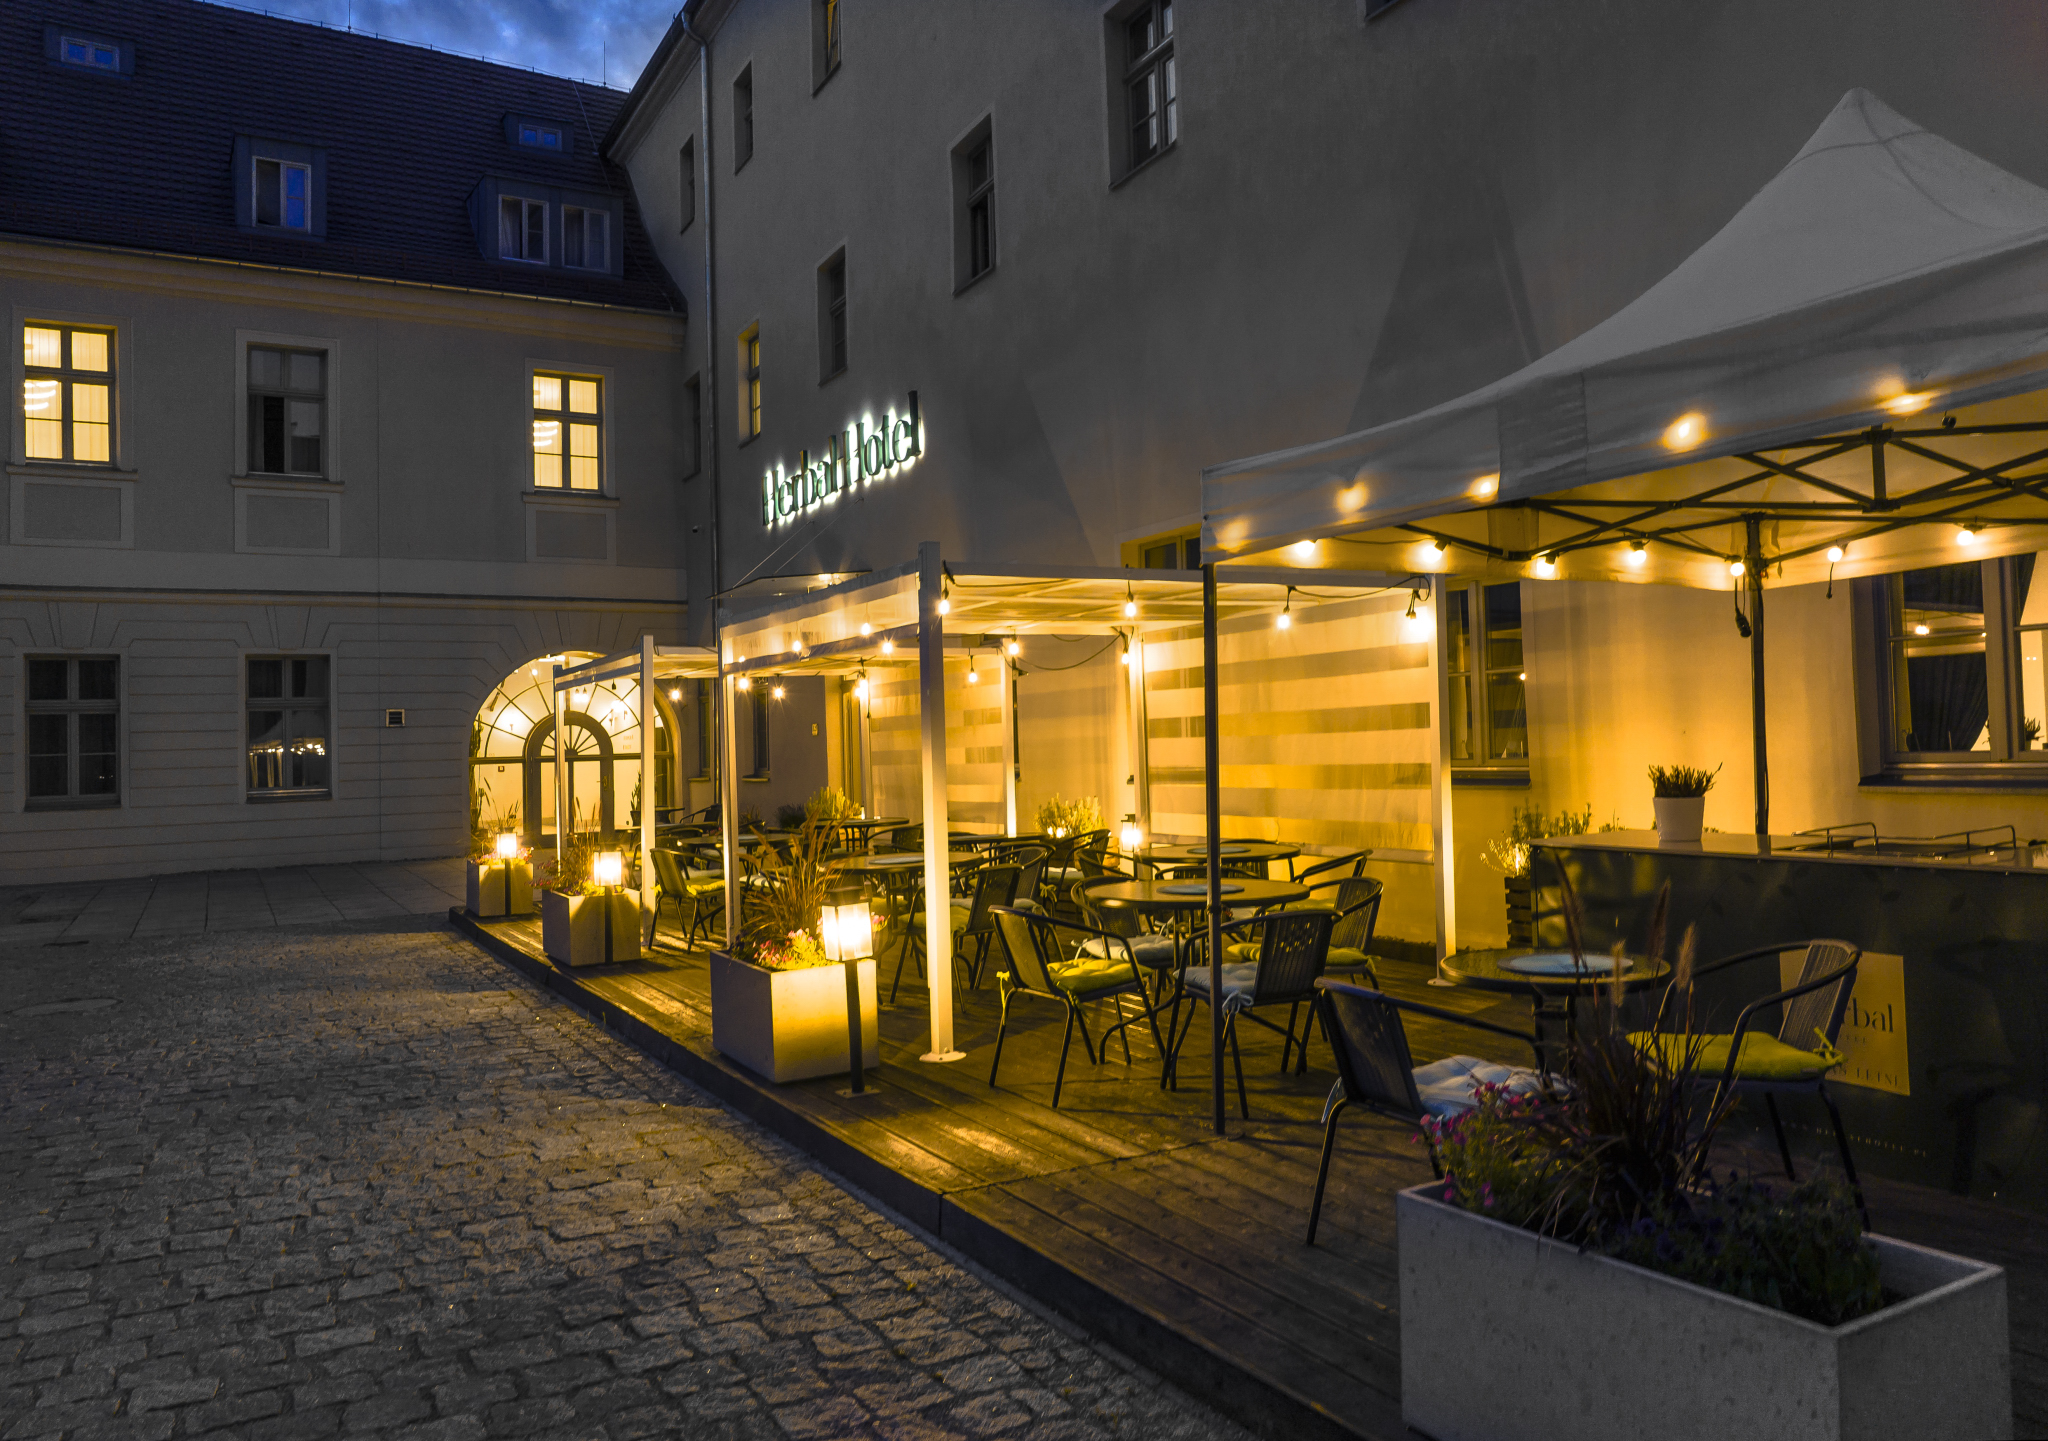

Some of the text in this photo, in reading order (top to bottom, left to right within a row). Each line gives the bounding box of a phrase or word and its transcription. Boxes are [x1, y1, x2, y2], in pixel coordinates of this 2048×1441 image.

[762, 390, 921, 526] Herbal Hotel
[1847, 996, 1894, 1034] bal
